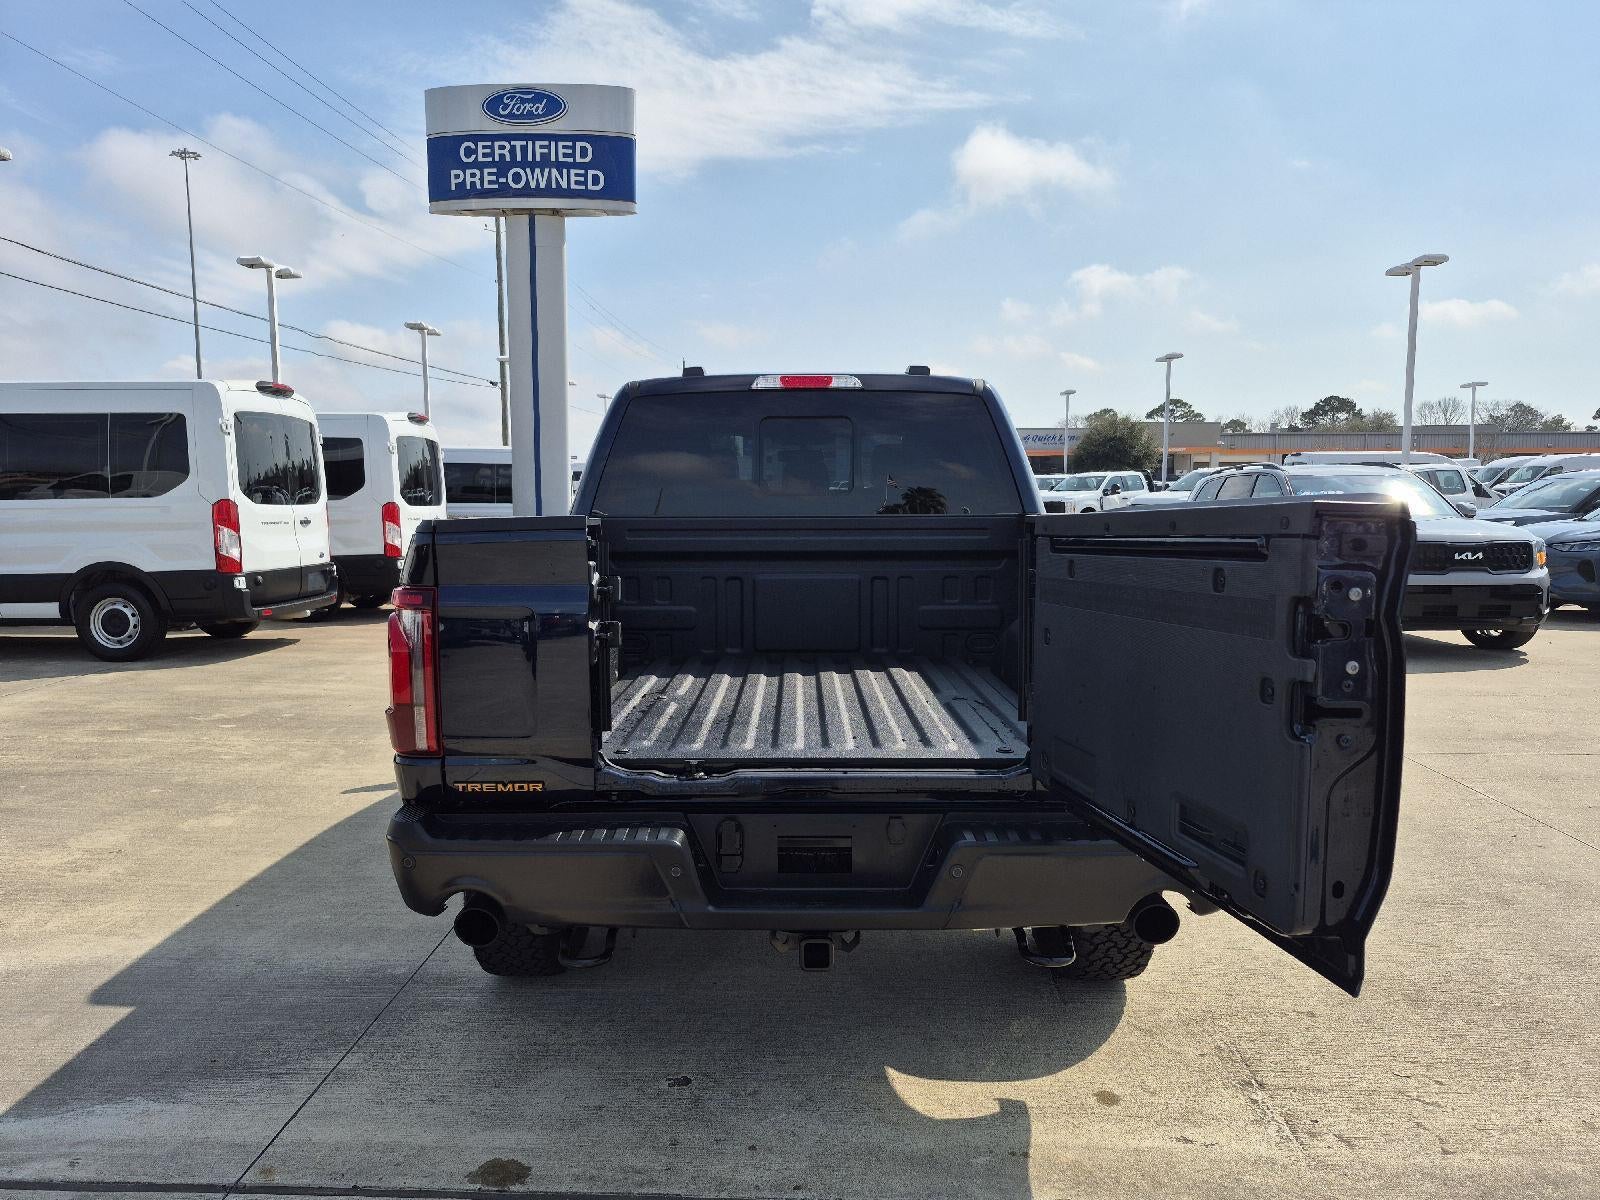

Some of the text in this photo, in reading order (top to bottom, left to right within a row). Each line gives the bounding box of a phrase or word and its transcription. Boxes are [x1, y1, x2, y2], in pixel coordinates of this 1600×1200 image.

[498, 93, 547, 115] Ford
[459, 140, 593, 163] CERTIFIED
[450, 167, 605, 191] PRE-OWNED
[1031, 434, 1058, 443] Quick
[453, 783, 543, 792] TREMOR
